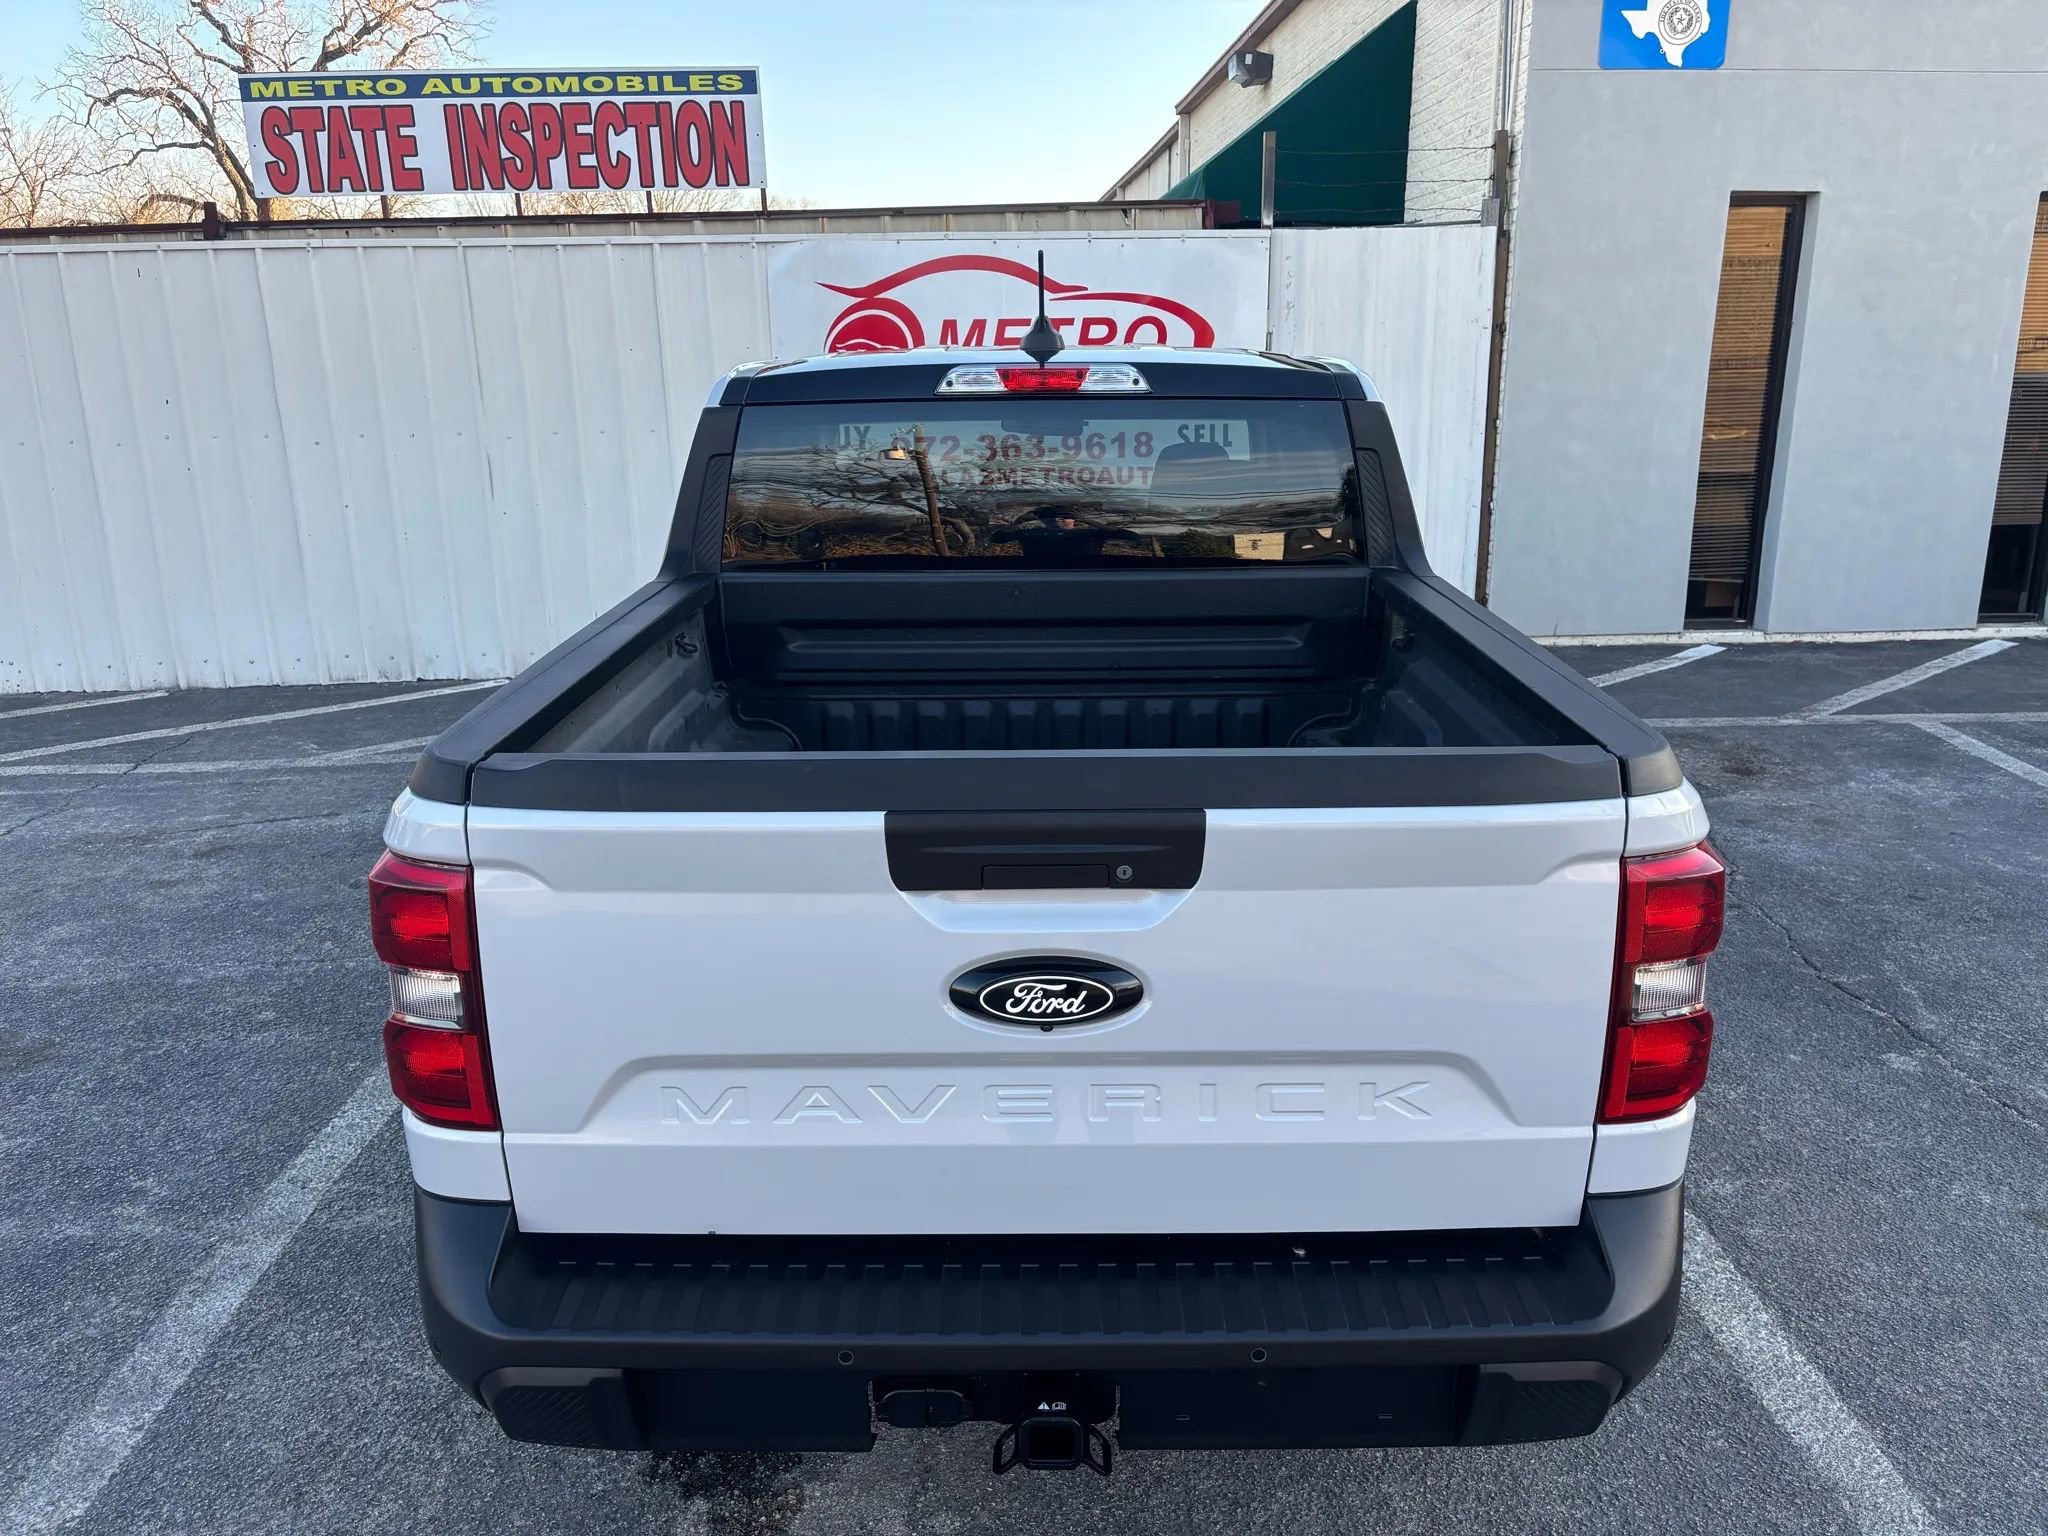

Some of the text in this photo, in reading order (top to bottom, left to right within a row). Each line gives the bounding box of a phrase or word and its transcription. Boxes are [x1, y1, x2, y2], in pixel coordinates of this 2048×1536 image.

[250, 73, 745, 99] METRO AUTOMOBILES
[261, 99, 750, 195] STATE INSPECTION
[837, 423, 1233, 450] UY SELL
[1006, 982, 1087, 1014] Ford
[660, 1081, 1434, 1125] MAVERICK
